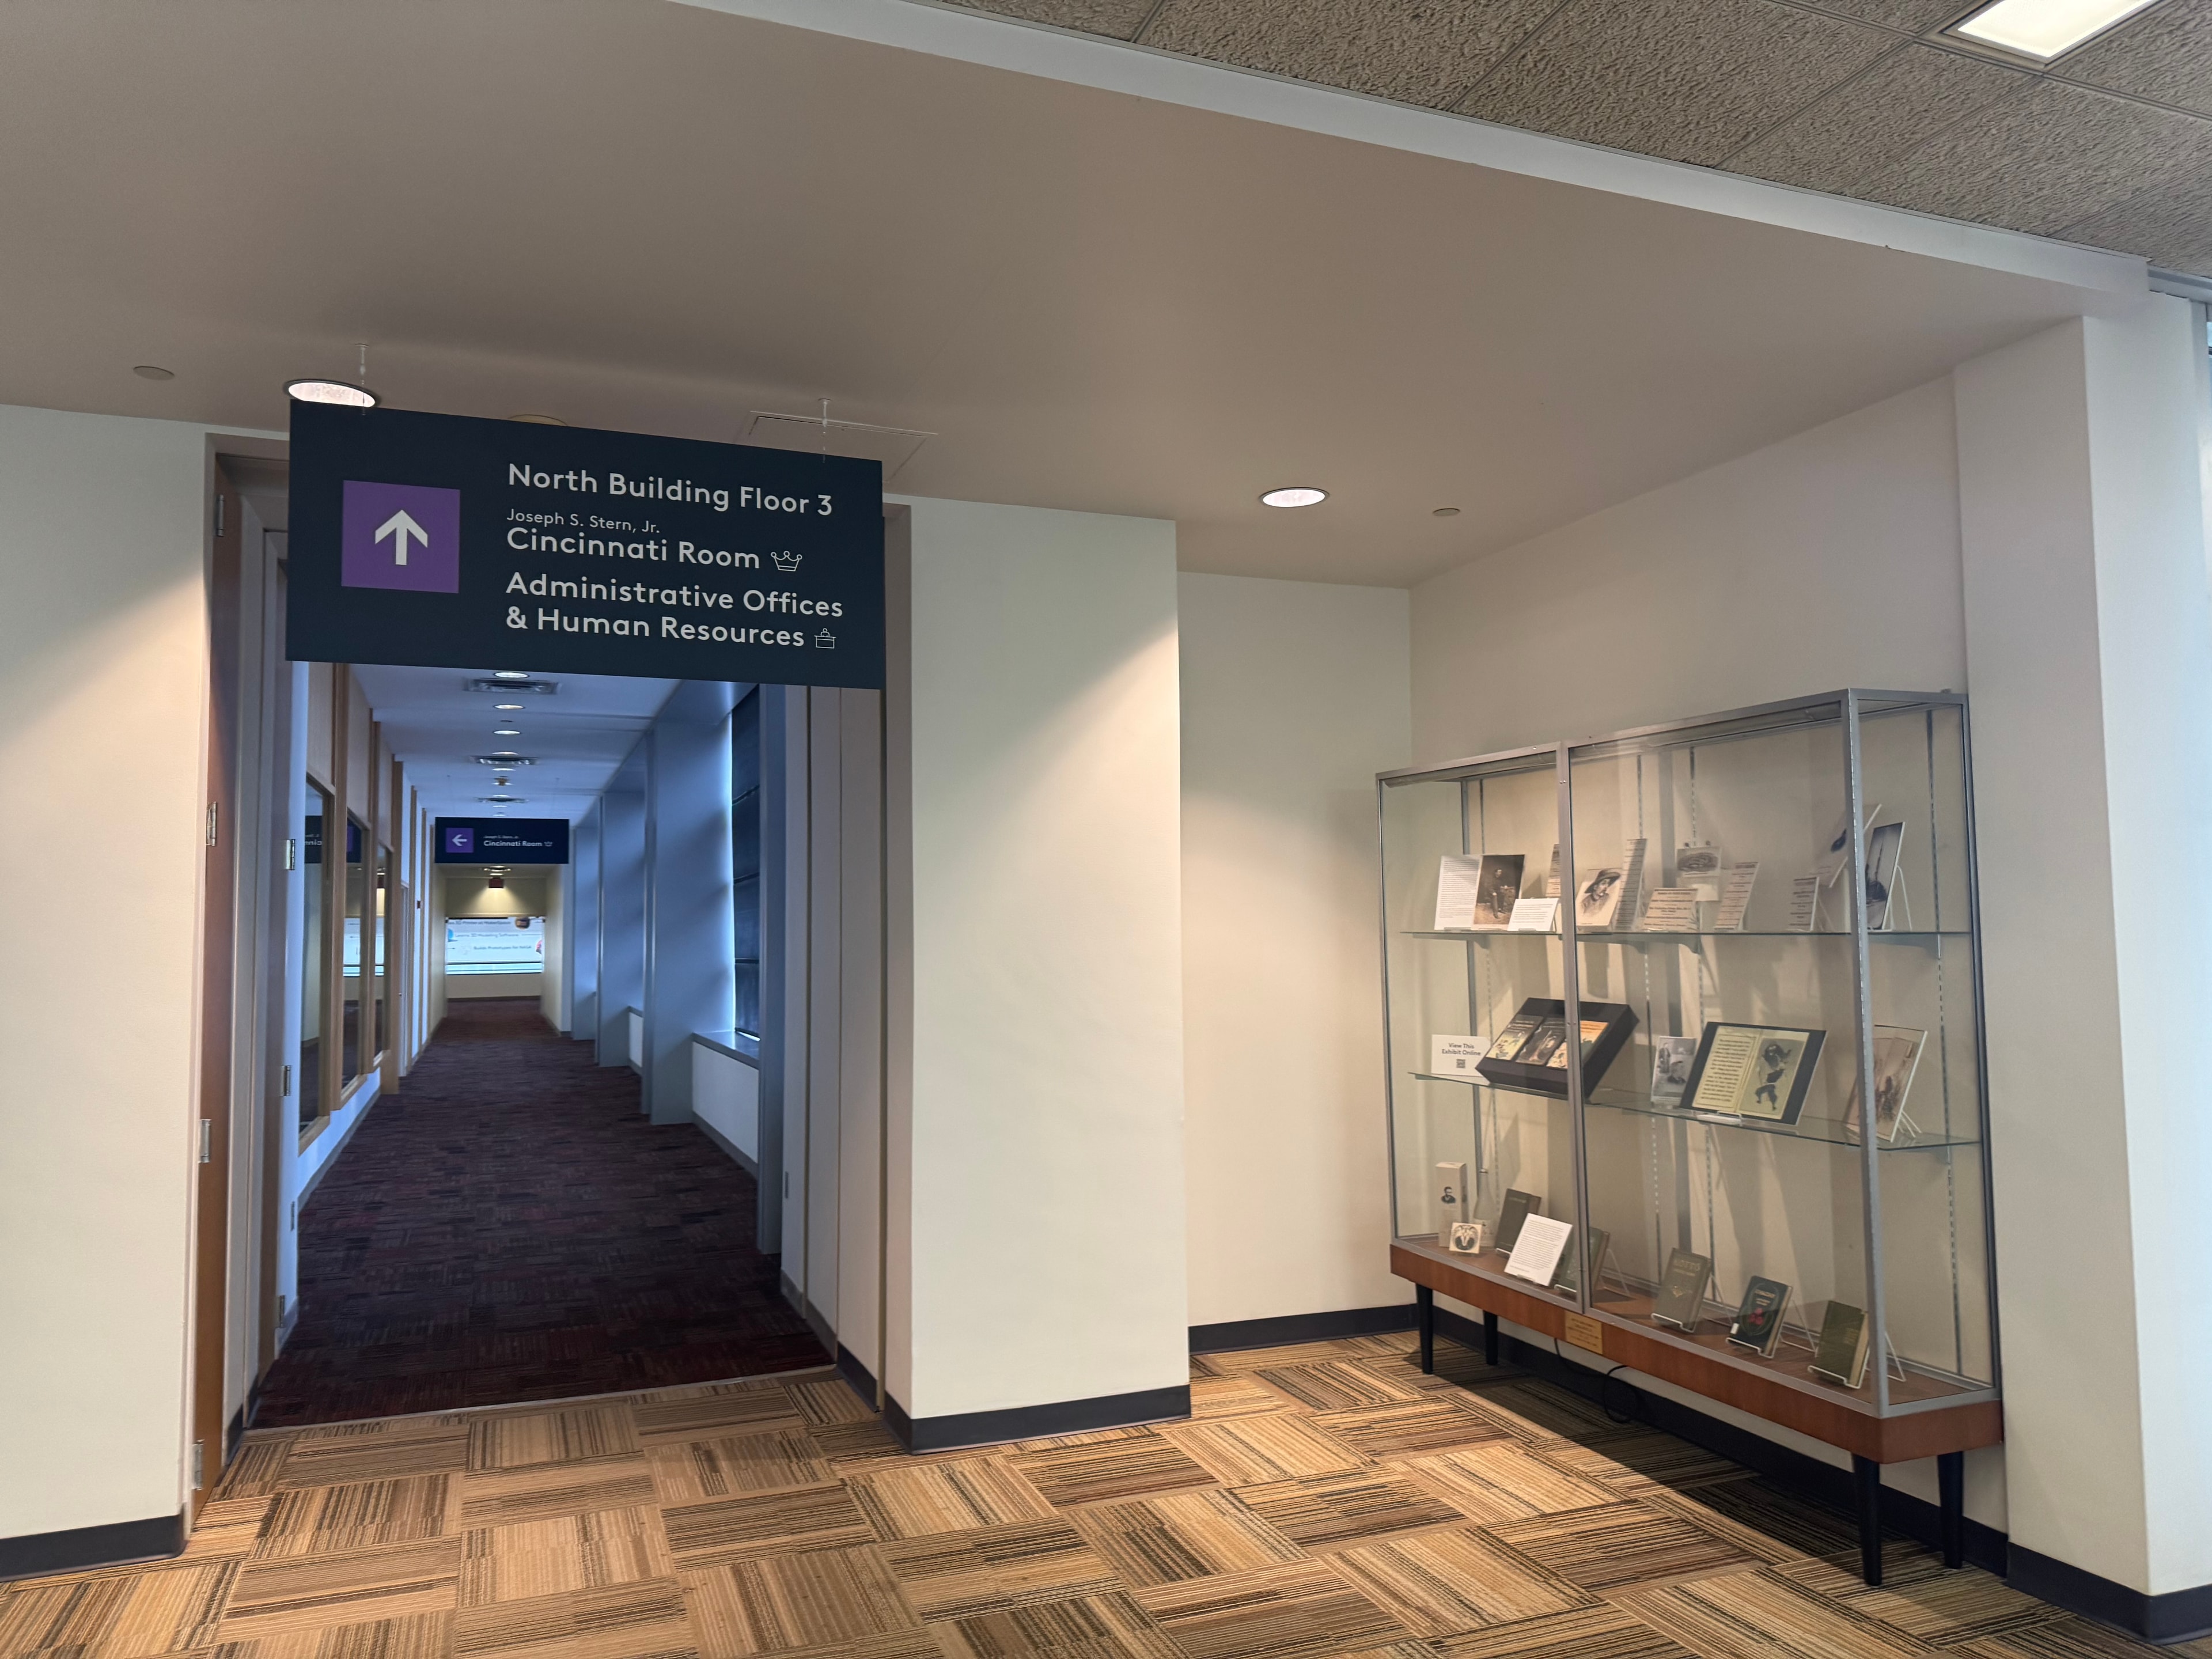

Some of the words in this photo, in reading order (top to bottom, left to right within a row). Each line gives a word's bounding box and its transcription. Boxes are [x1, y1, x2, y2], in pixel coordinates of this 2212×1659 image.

[509, 463, 597, 493] North
[609, 473, 729, 512] Building
[740, 487, 809, 515] Floor
[817, 494, 832, 516] 3
[507, 509, 564, 527] Joseph
[570, 514, 584, 527] S.
[589, 516, 637, 533] Stern,
[641, 520, 660, 533] Jr.
[507, 527, 666, 561] Cincinnati
[679, 541, 759, 569] Room
[505, 571, 733, 609] Administrative
[743, 589, 843, 617] Offices
[506, 606, 528, 629] &
[538, 608, 649, 637] Human
[661, 616, 804, 646] Resources
